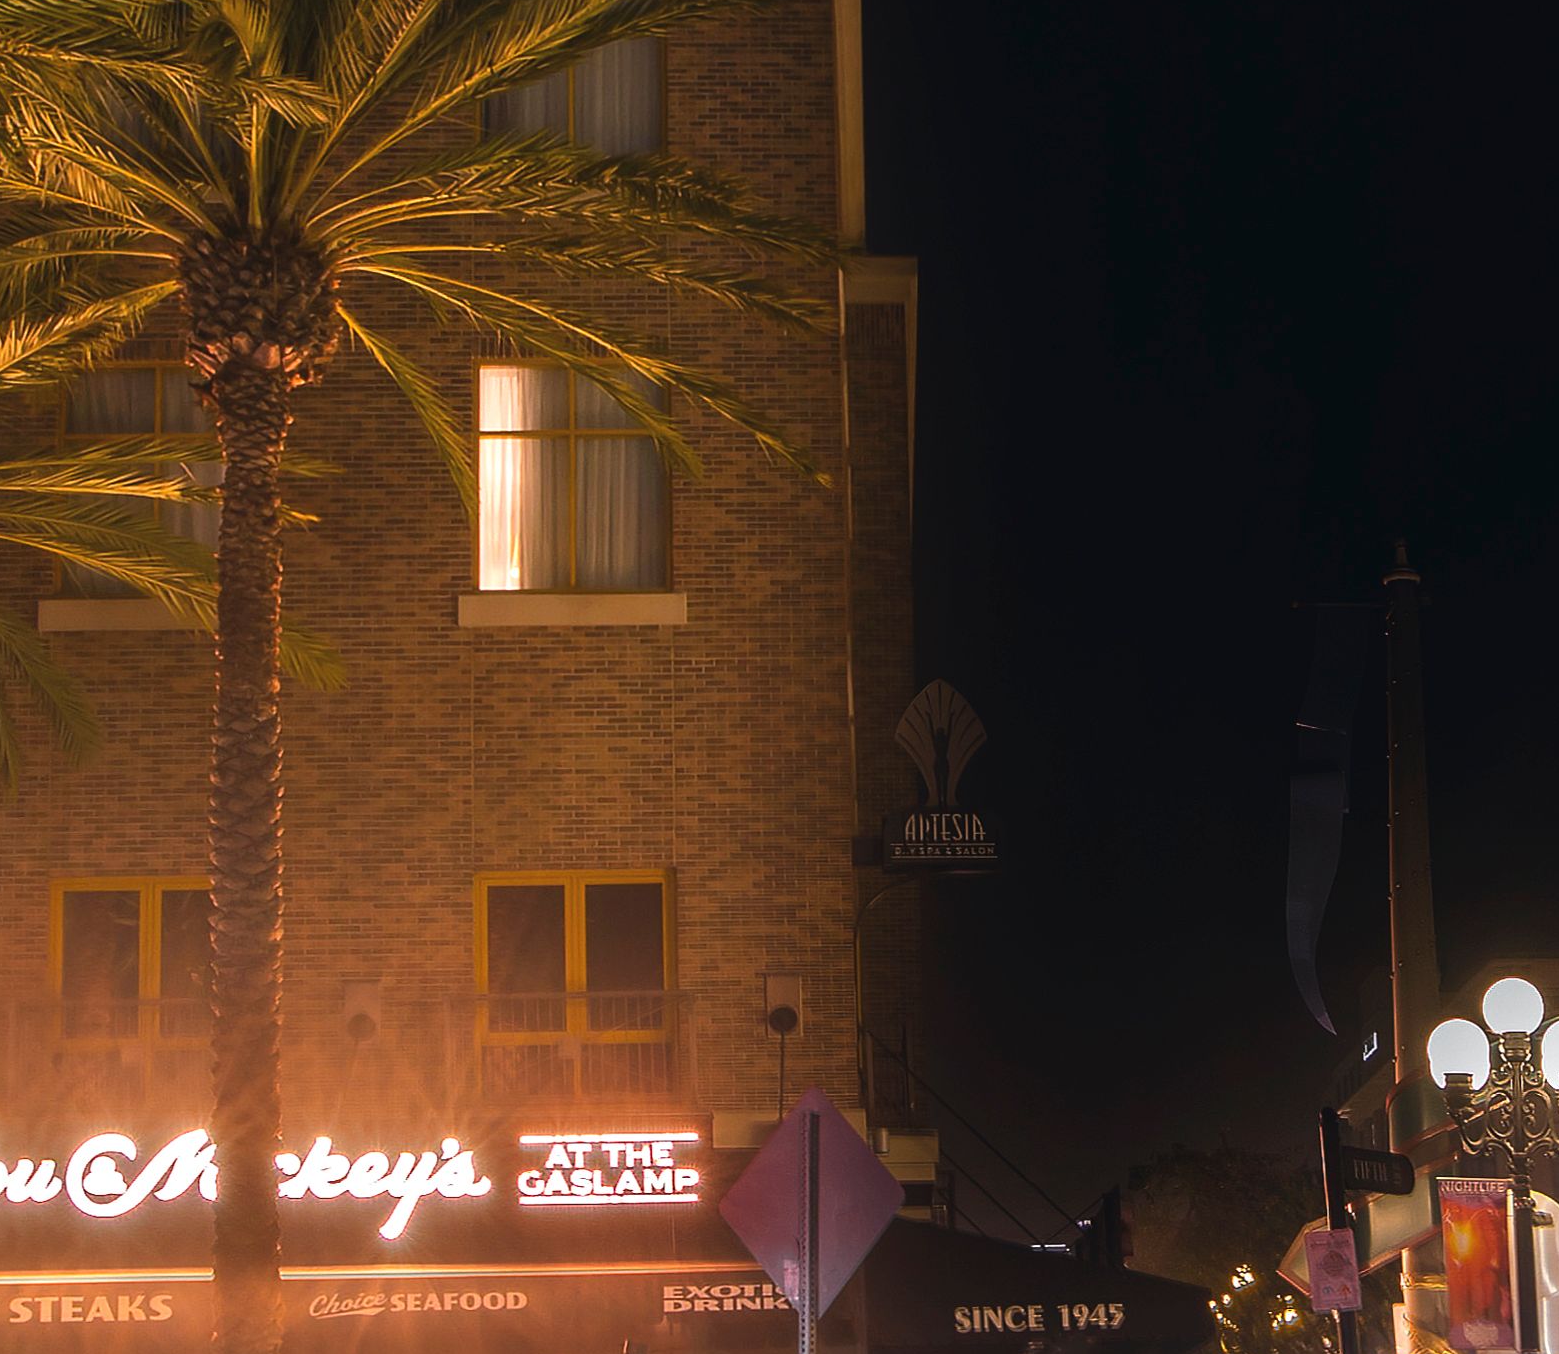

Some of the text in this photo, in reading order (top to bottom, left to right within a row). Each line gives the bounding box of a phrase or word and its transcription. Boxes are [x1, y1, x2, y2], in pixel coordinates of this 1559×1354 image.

[904, 813, 986, 842] ARTESIA
[545, 1142, 673, 1169] AT THE
[517, 1168, 699, 1197] GASLAMP
[1354, 1159, 1388, 1182] FIFTH
[1441, 1181, 1506, 1192] NIGHTLIFE
[9, 1294, 173, 1323] STEAKS
[309, 1291, 528, 1320] Choice SEAFOOD
[954, 1303, 1125, 1333] SINCE 1945
